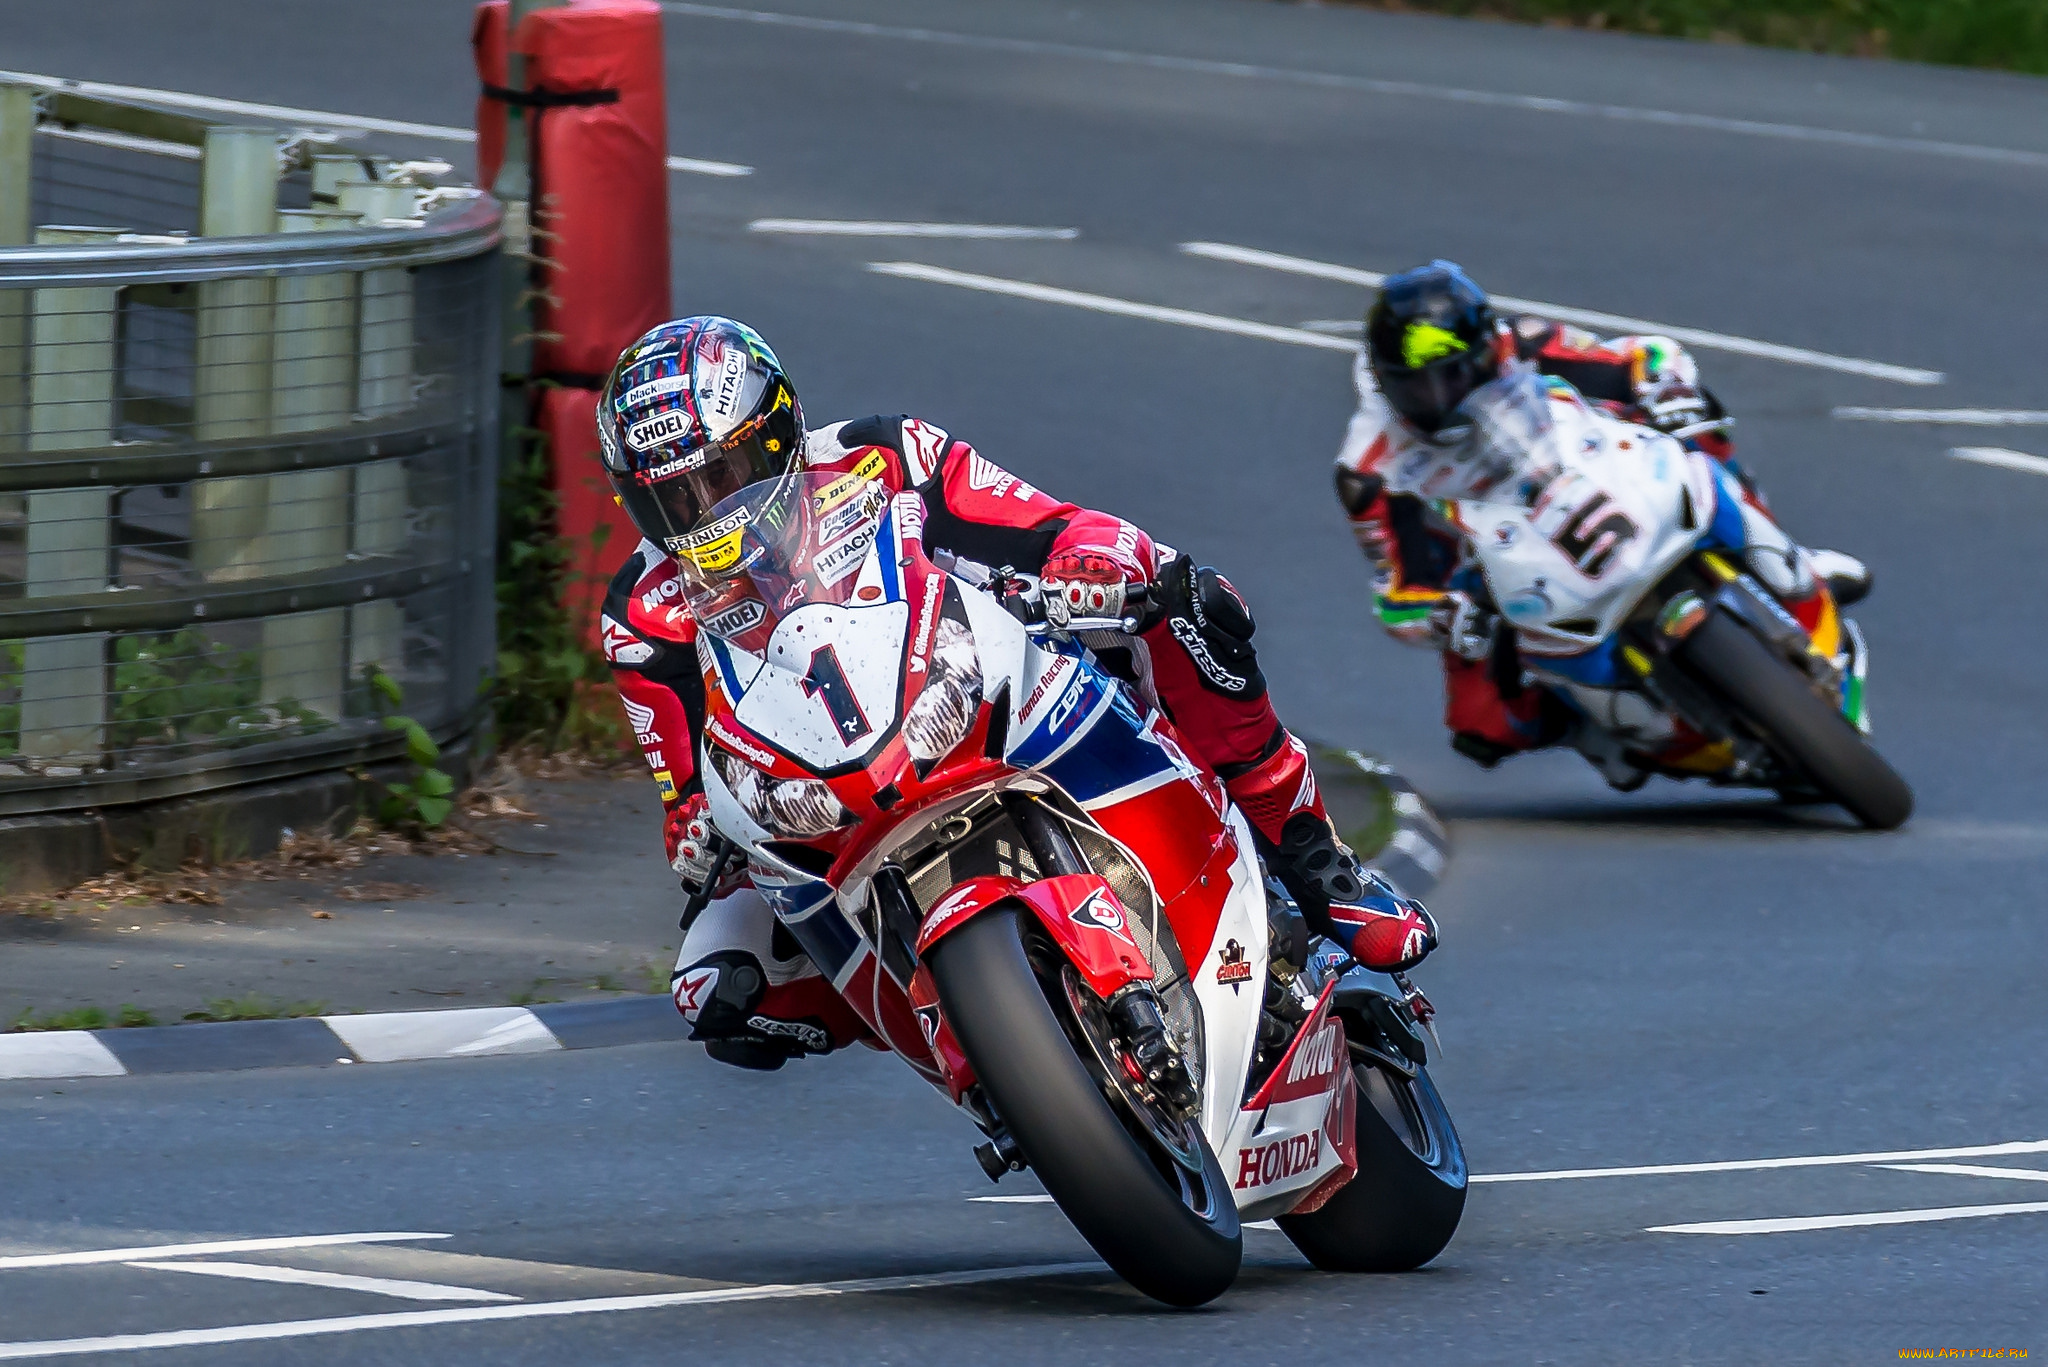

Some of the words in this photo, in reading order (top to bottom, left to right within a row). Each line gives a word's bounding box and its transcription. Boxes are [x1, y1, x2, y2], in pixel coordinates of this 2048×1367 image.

[715, 350, 738, 416] HITACHI
[633, 415, 683, 445] SHOEI
[650, 448, 705, 479] halsall
[667, 511, 749, 550] DENNISON
[1551, 492, 1638, 580] 5
[801, 643, 873, 748] 1
[1018, 685, 1045, 725] Honda
[1040, 654, 1071, 689] Racing
[1048, 667, 1093, 736] CBR
[1234, 1129, 1319, 1190] HONDA
